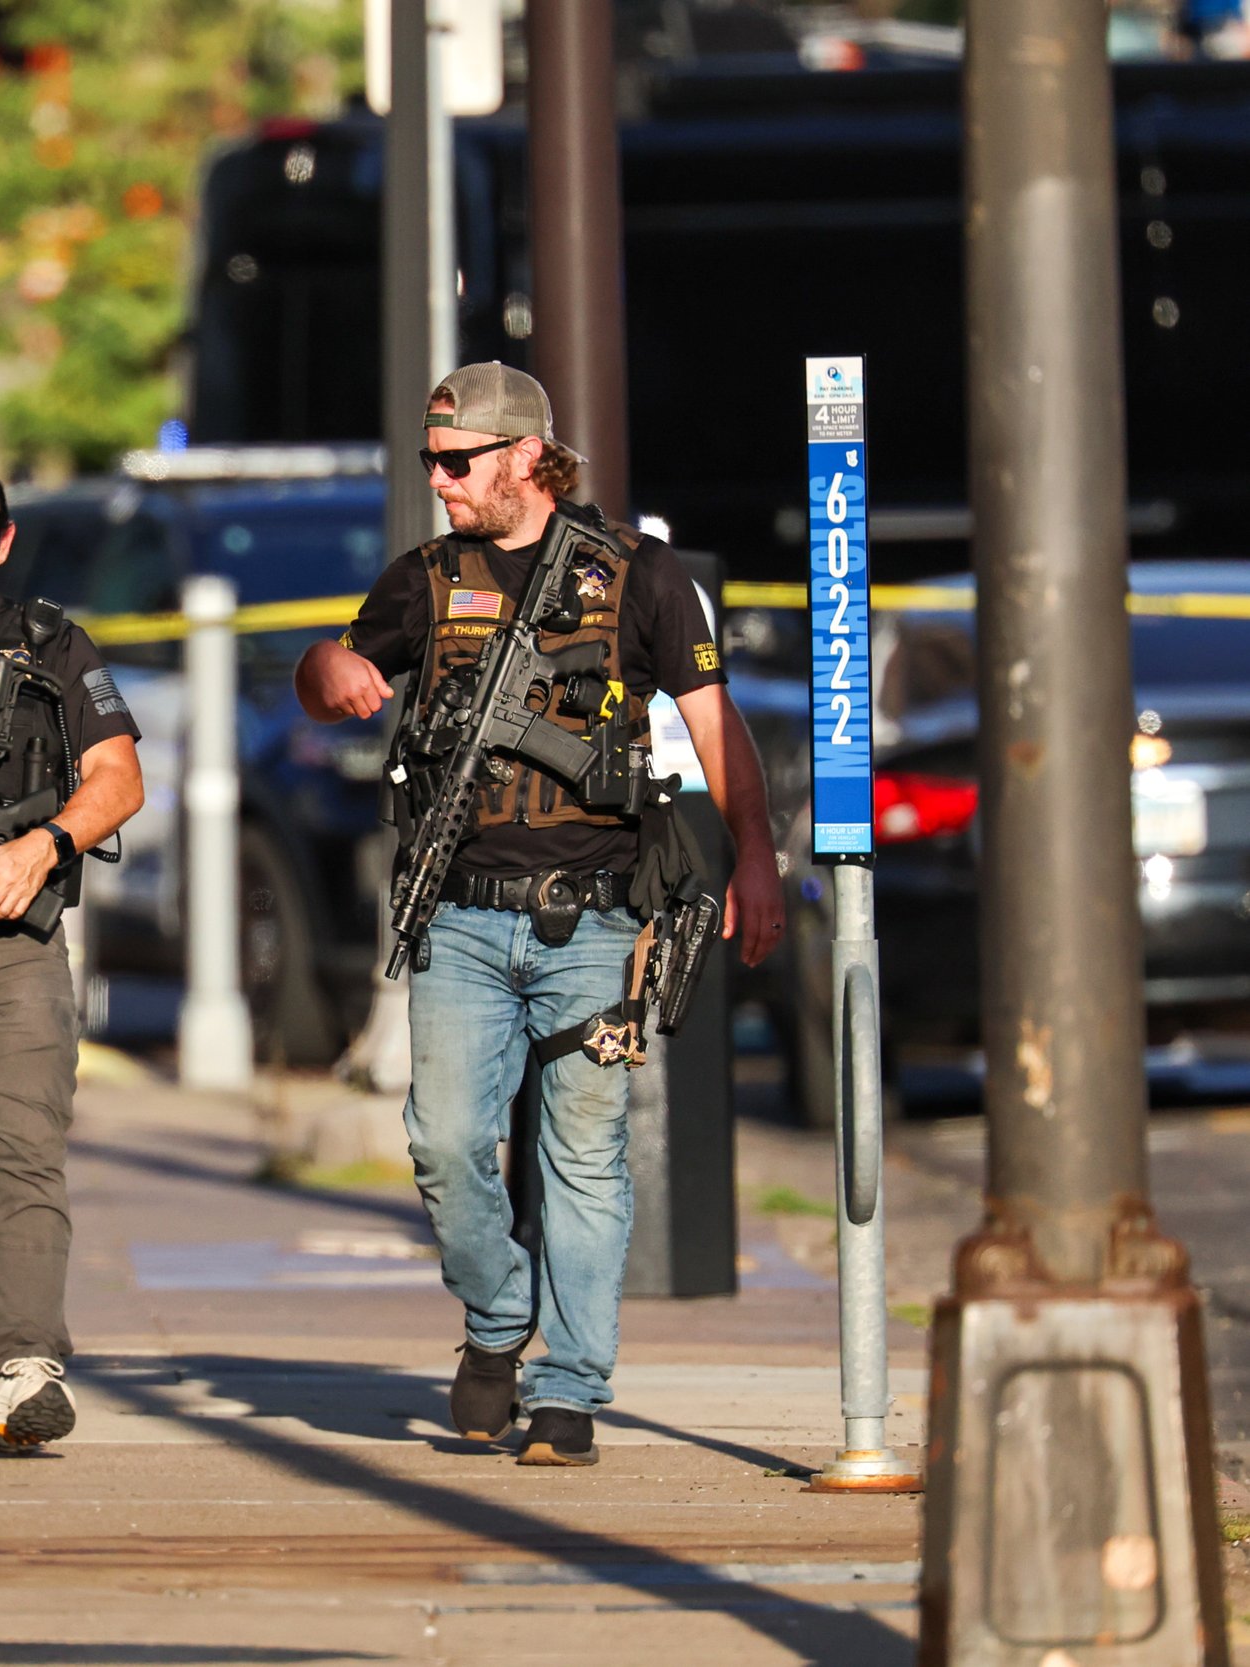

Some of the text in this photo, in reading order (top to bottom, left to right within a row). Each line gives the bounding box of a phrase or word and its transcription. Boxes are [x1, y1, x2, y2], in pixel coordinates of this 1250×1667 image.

[815, 405, 857, 425] 4 HOUR
[831, 415, 856, 425] LIMIT
[826, 472, 852, 745] 60222
